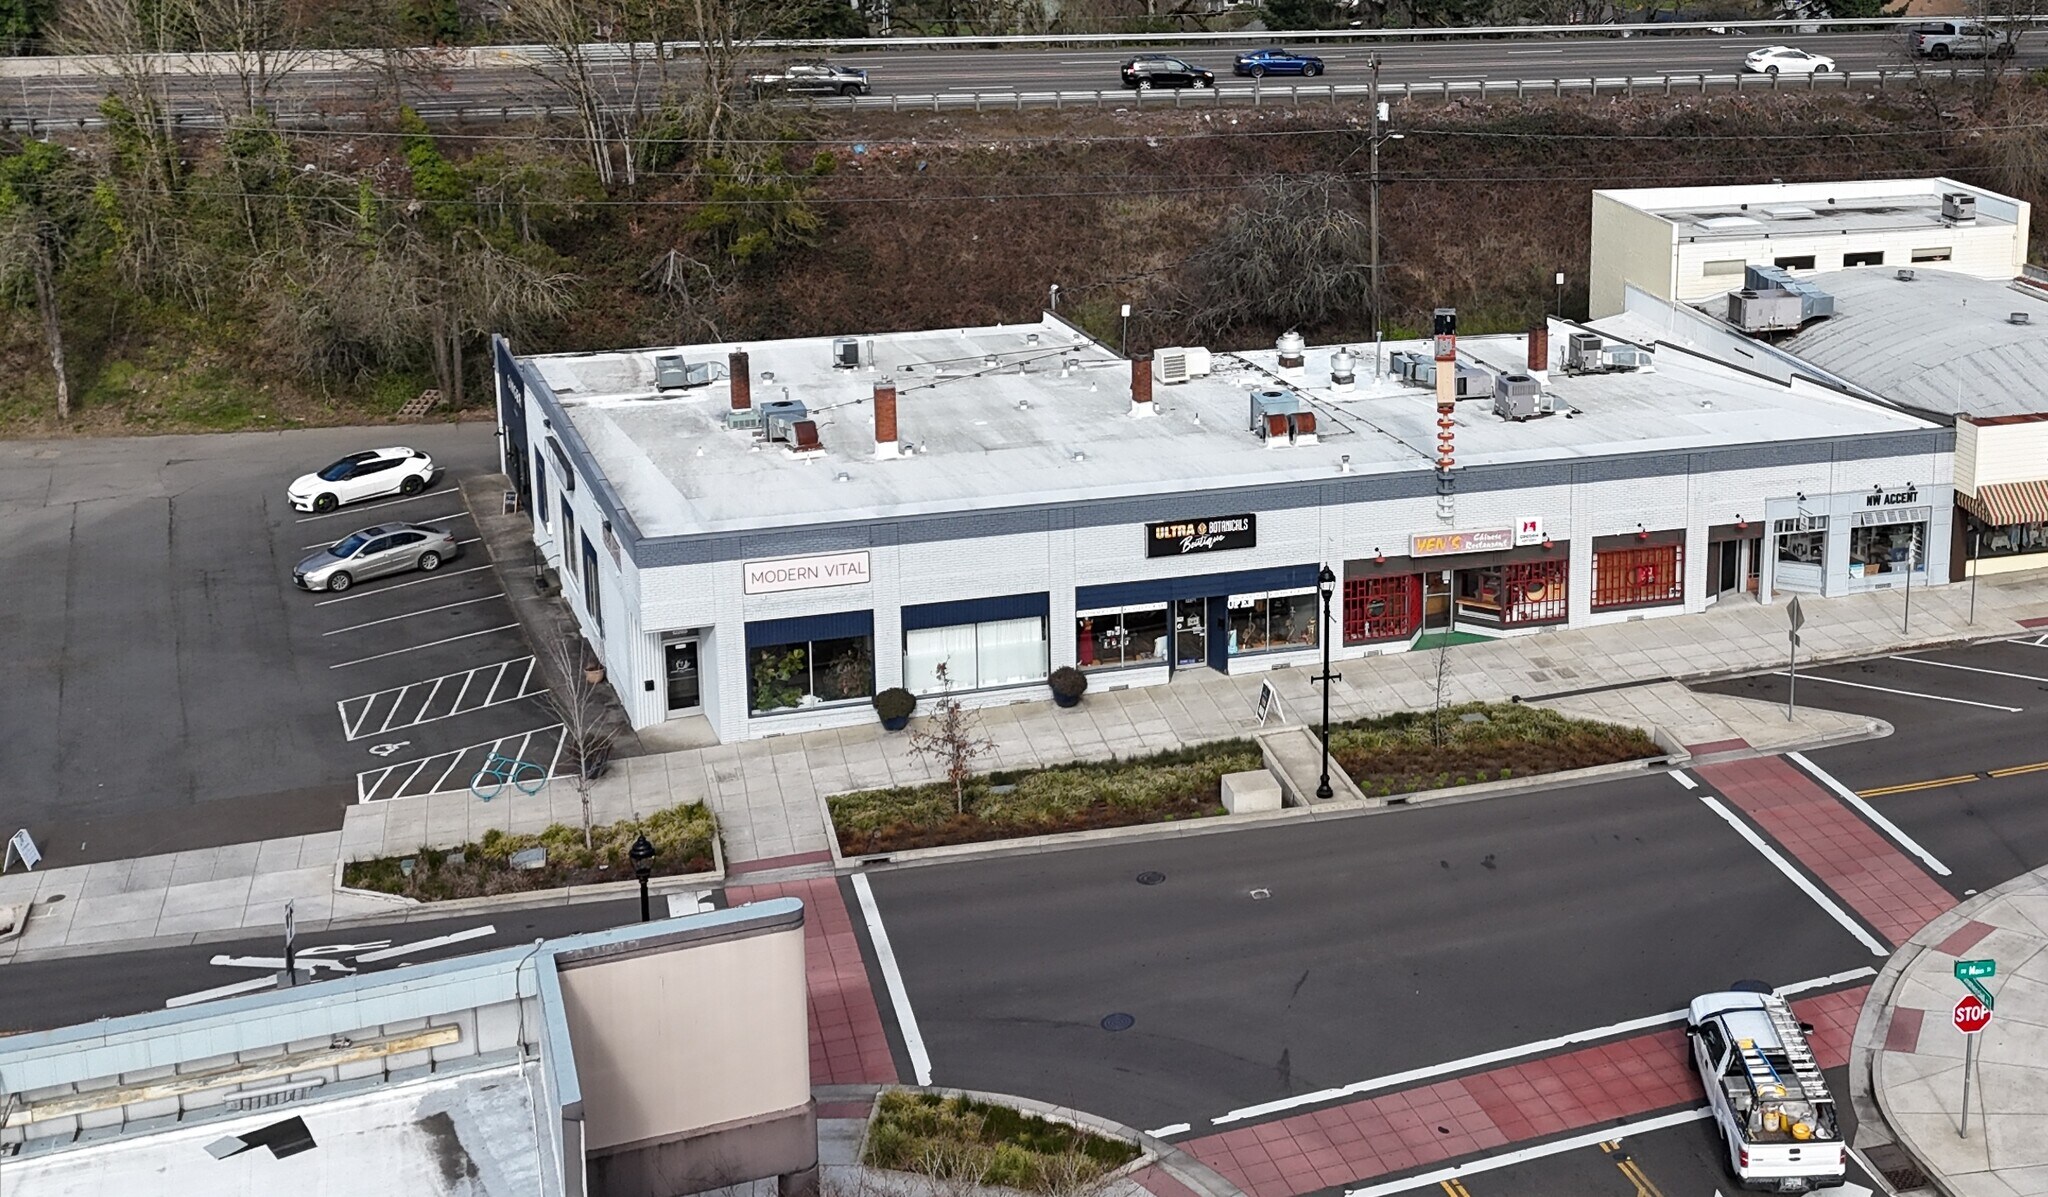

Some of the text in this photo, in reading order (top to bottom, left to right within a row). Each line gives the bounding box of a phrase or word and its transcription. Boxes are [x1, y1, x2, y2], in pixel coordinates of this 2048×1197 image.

[1866, 491, 1919, 506] NW ACCENT
[1155, 518, 1249, 539] ULTRA BOTANICALS
[1473, 532, 1502, 542] Chinese
[1179, 534, 1226, 553] Boutique
[1416, 535, 1462, 553] YEN'S
[1465, 538, 1508, 550] Restaurant
[751, 562, 867, 585] MODERN VITAL
[1956, 1005, 1989, 1022] STOP
